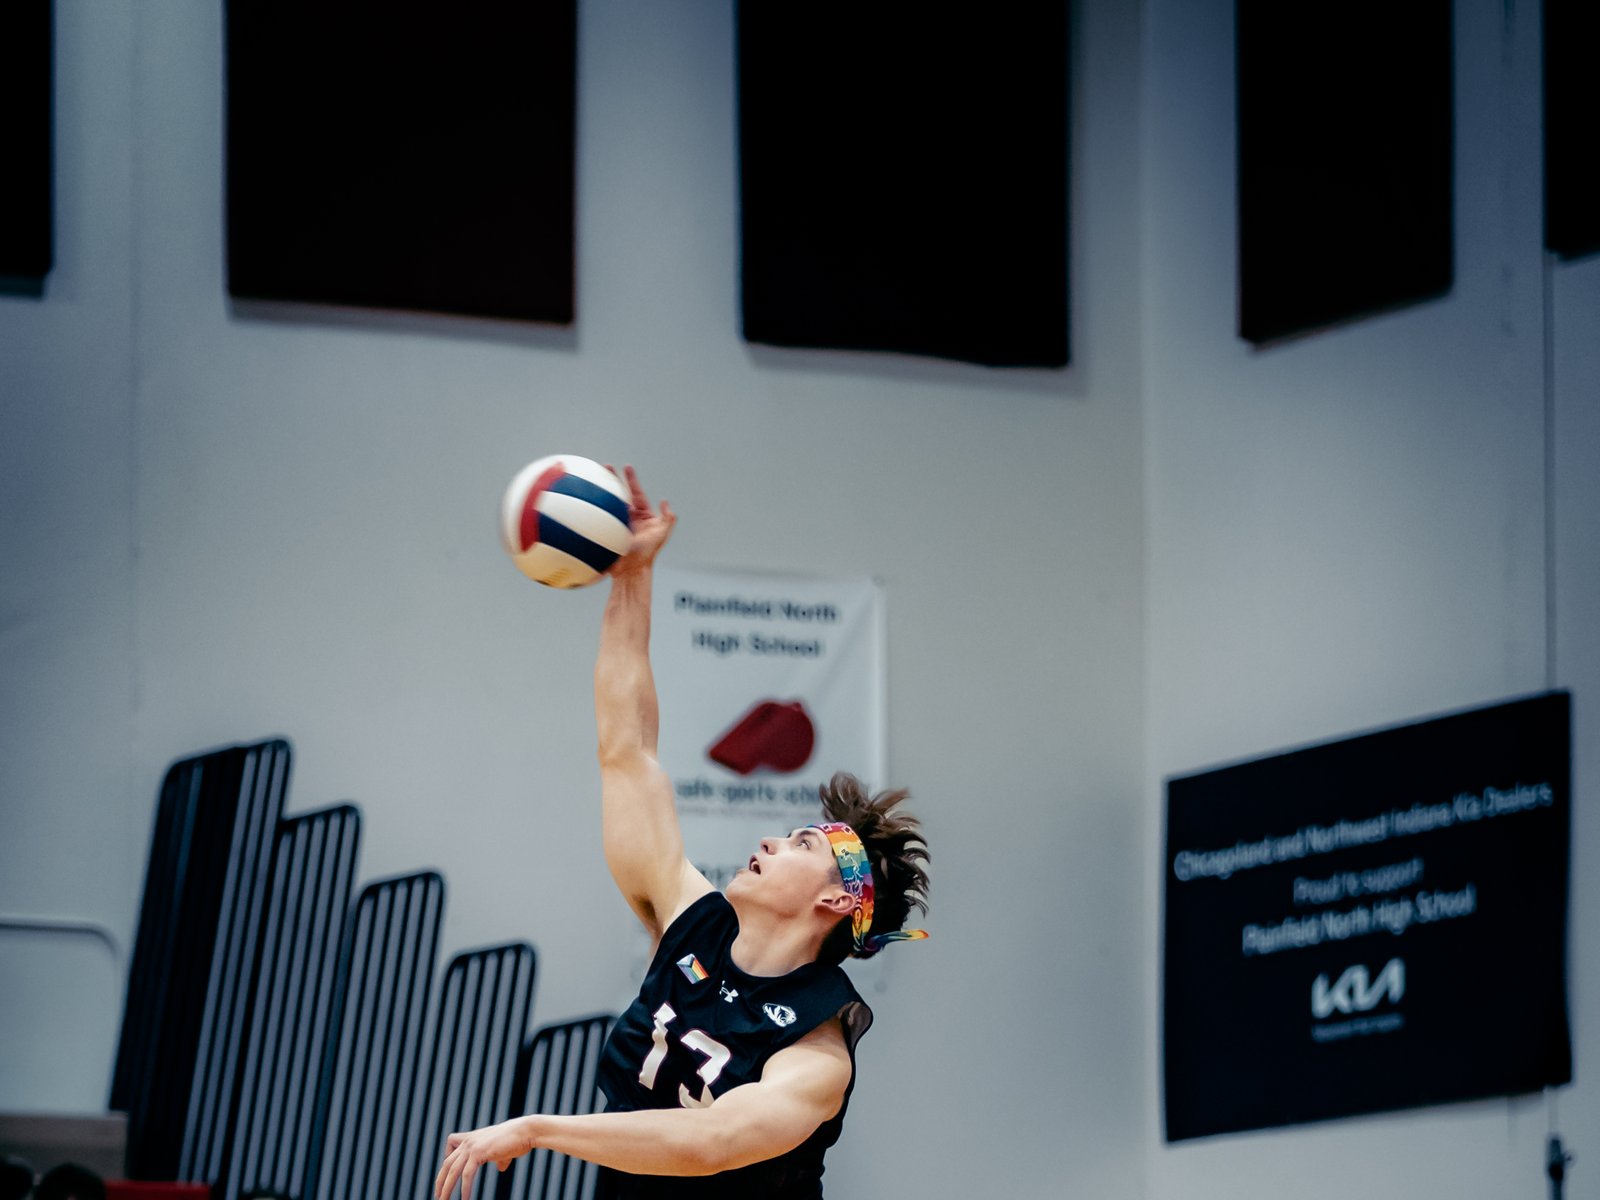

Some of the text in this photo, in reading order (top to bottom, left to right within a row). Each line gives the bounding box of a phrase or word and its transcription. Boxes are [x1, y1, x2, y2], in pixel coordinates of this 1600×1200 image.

[780, 603, 838, 622] North
[691, 631, 821, 656] High School
